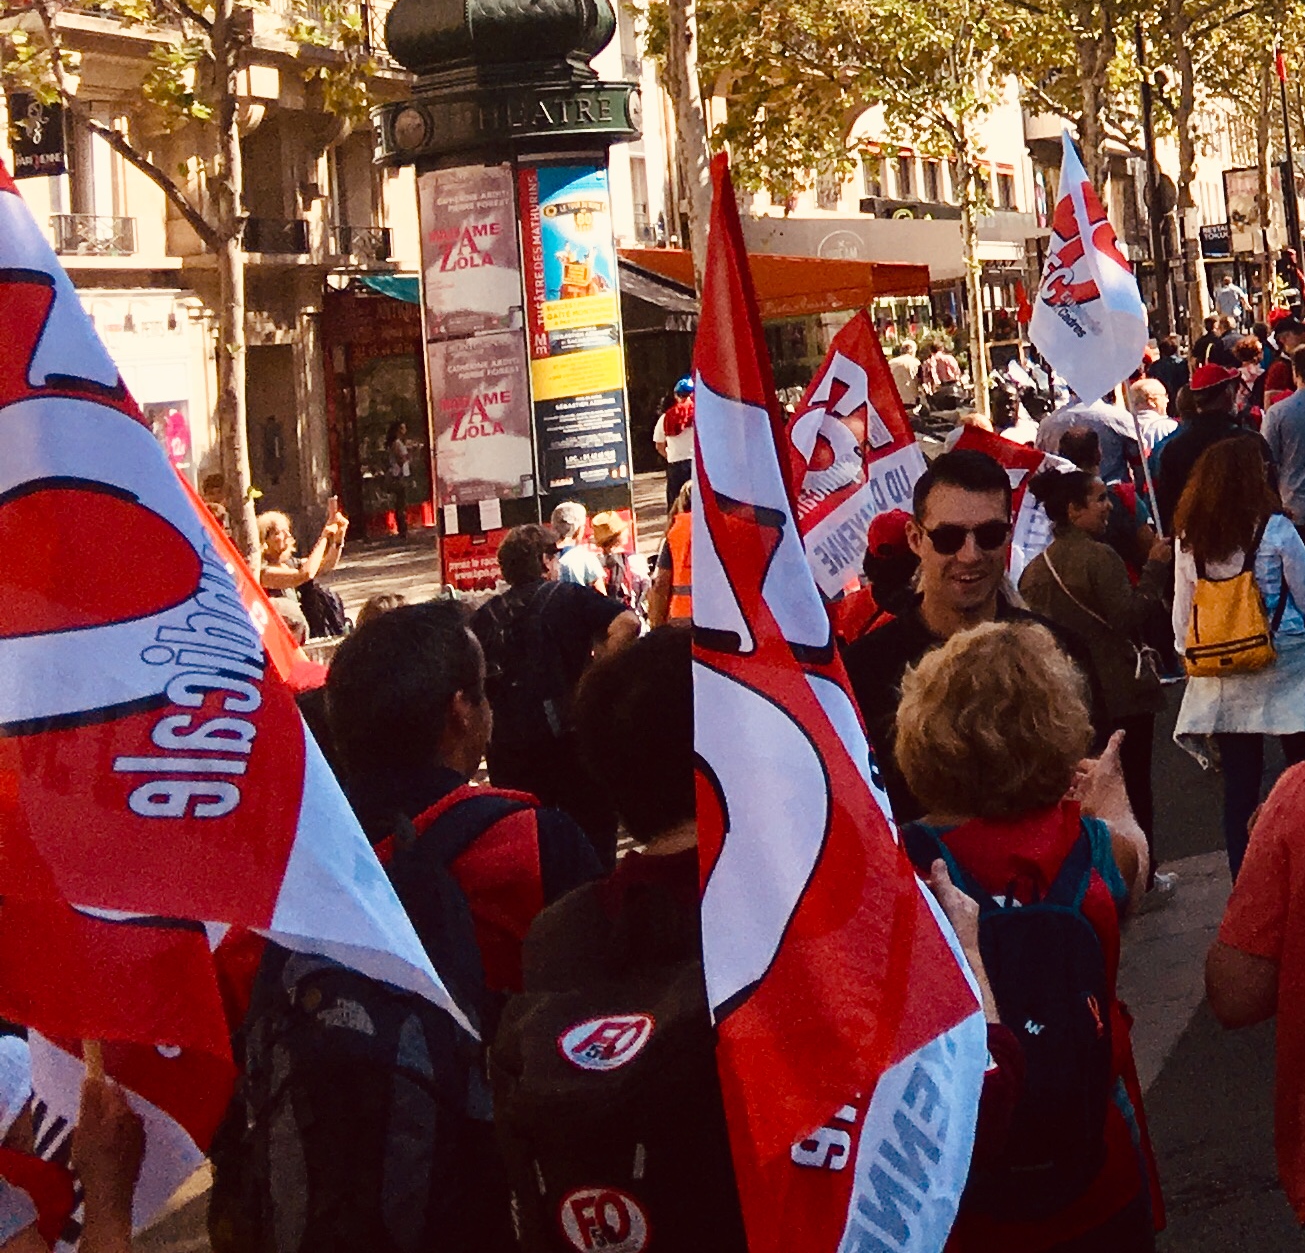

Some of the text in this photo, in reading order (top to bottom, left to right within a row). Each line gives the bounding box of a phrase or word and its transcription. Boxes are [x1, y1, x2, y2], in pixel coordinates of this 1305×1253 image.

[527, 175, 541, 249] MATHURINS
[440, 242, 494, 273] ZOLA
[532, 249, 544, 270] DES
[1057, 308, 1087, 338] Cadres
[450, 411, 505, 441] ZOLA
[570, 1192, 633, 1251] FO
